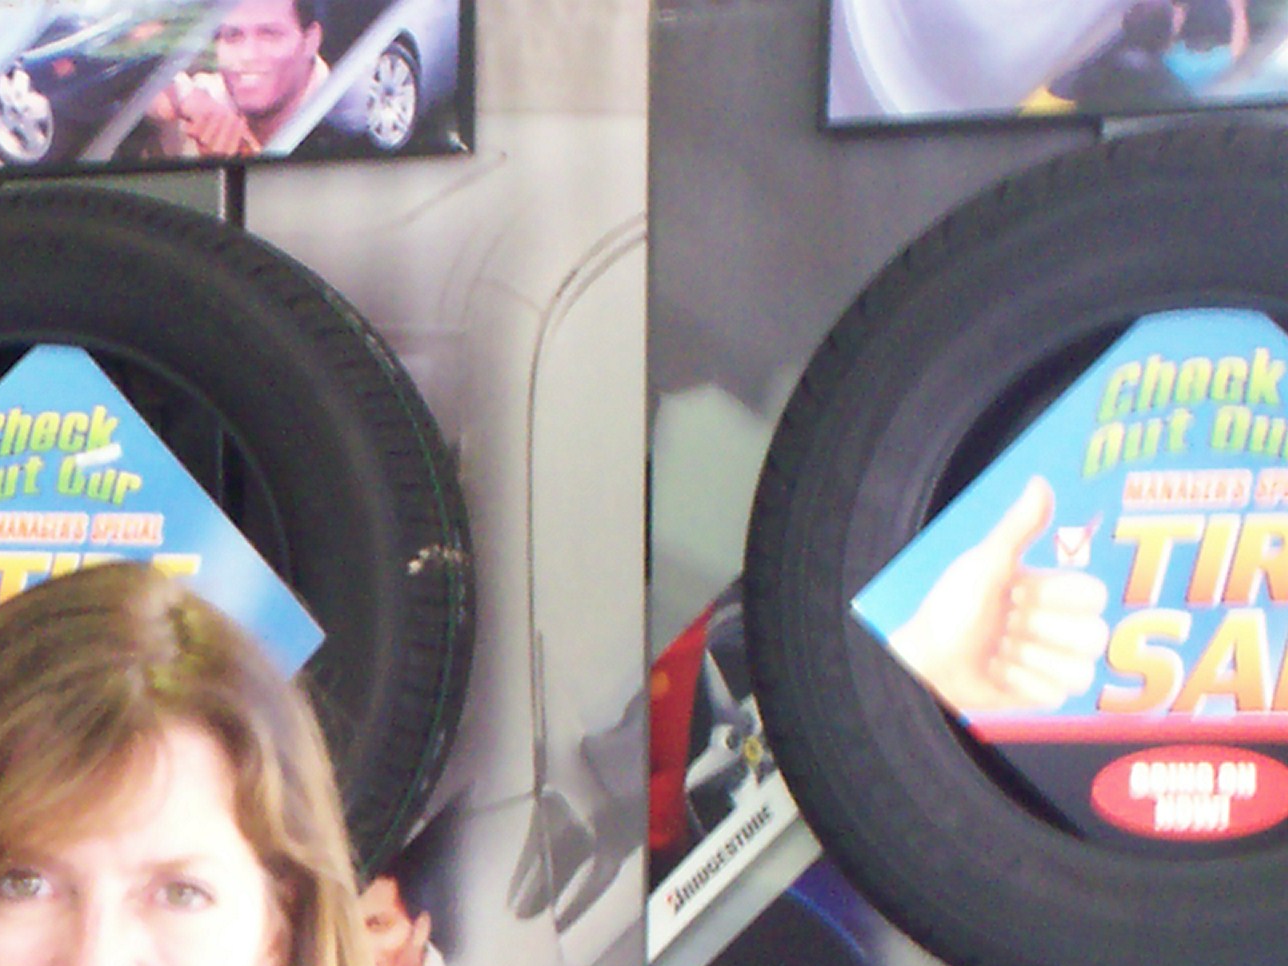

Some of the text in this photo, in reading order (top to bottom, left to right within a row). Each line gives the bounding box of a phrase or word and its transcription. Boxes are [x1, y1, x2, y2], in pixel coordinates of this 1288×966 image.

[1095, 346, 1285, 424] Check
[1081, 404, 1288, 482] Out Ou
[56, 453, 143, 507] Our
[91, 512, 164, 546] SPECIAL
[1096, 607, 1288, 716] SA
[1129, 761, 1257, 799] GOING ON
[1154, 794, 1231, 833] NOW!
